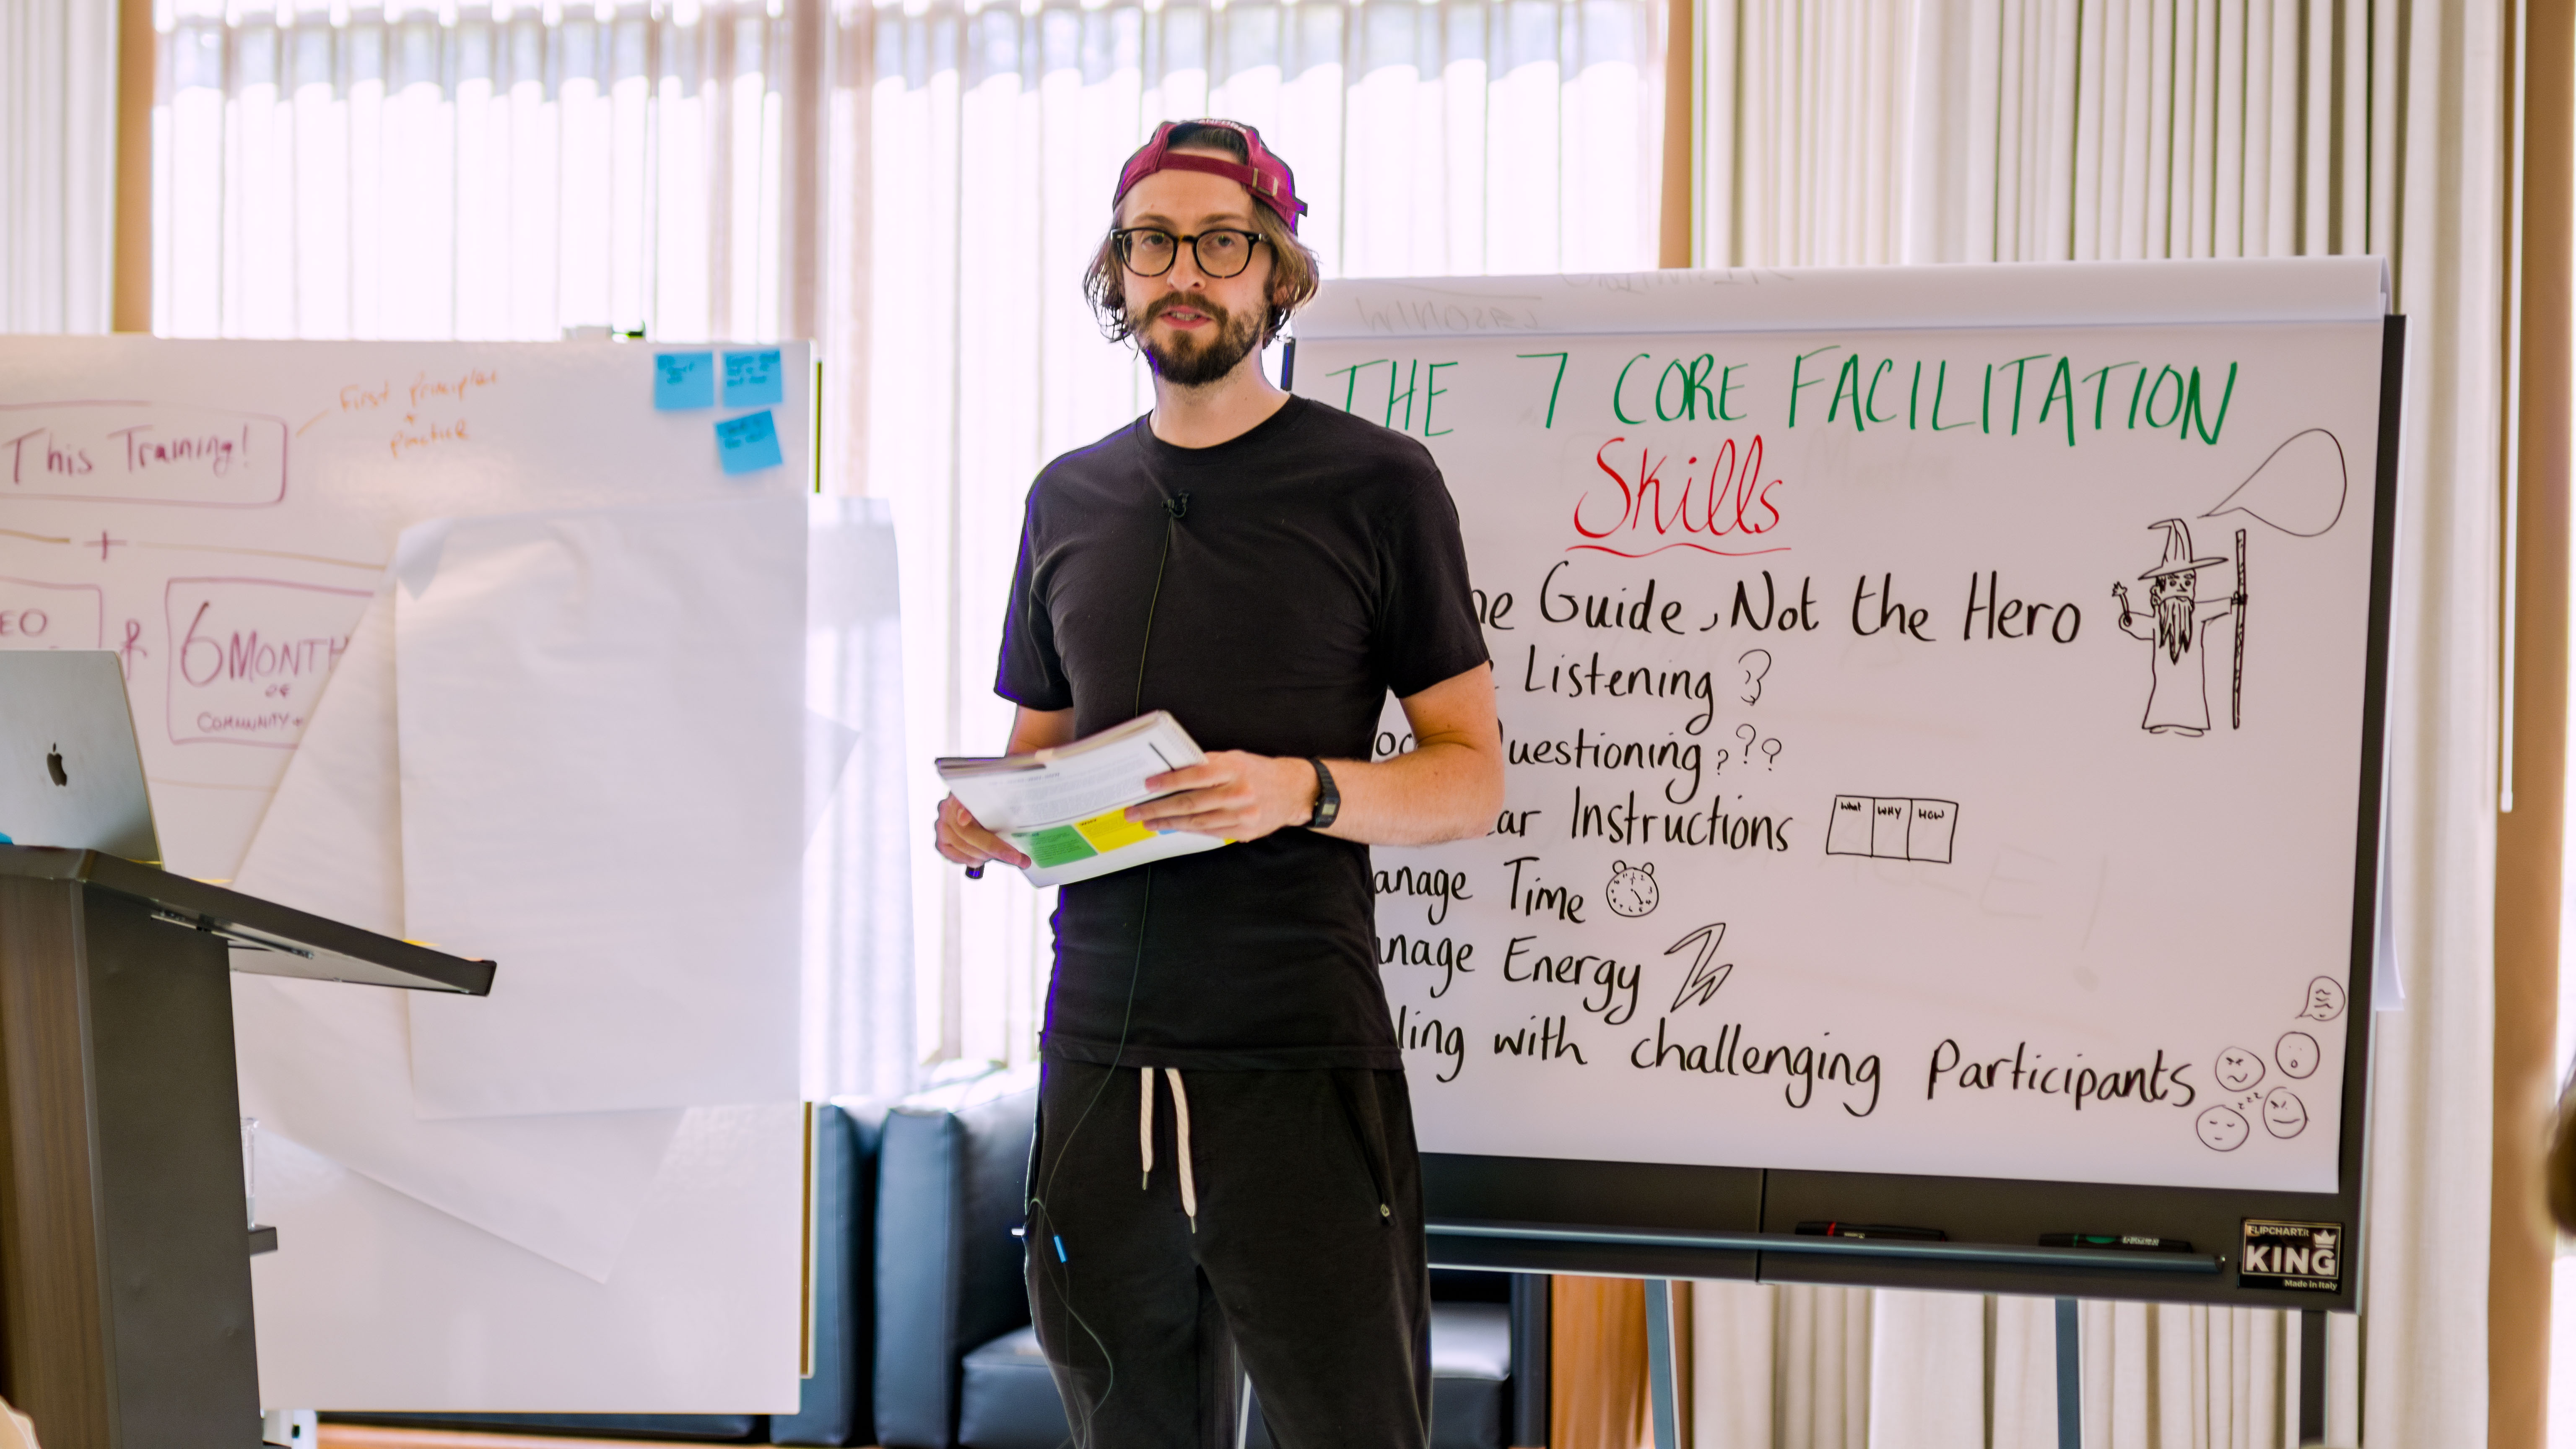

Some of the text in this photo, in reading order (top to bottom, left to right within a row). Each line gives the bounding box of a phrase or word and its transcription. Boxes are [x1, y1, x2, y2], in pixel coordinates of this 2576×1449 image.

[1326, 345, 2238, 447] THE 7 CORE FACILITATION
[1, 427, 92, 485] This
[1574, 434, 1783, 539] Skills
[179, 600, 223, 687] 6
[1731, 570, 1819, 631] Not
[1852, 572, 1936, 642] the
[1963, 570, 2081, 644] Hero
[1524, 644, 1714, 735] Listening
[1498, 718, 1701, 804] uestioning
[1571, 787, 1793, 852] Instructions
[1877, 806, 1902, 820] WHY
[1918, 808, 1945, 820] HOW
[1374, 857, 1586, 925] anage Time
[1376, 934, 1641, 1025] nage Energy
[1397, 1005, 2197, 1117] ling with challenging Participants
[2246, 1244, 2336, 1275] KING
[2319, 1281, 2338, 1291] Italy
